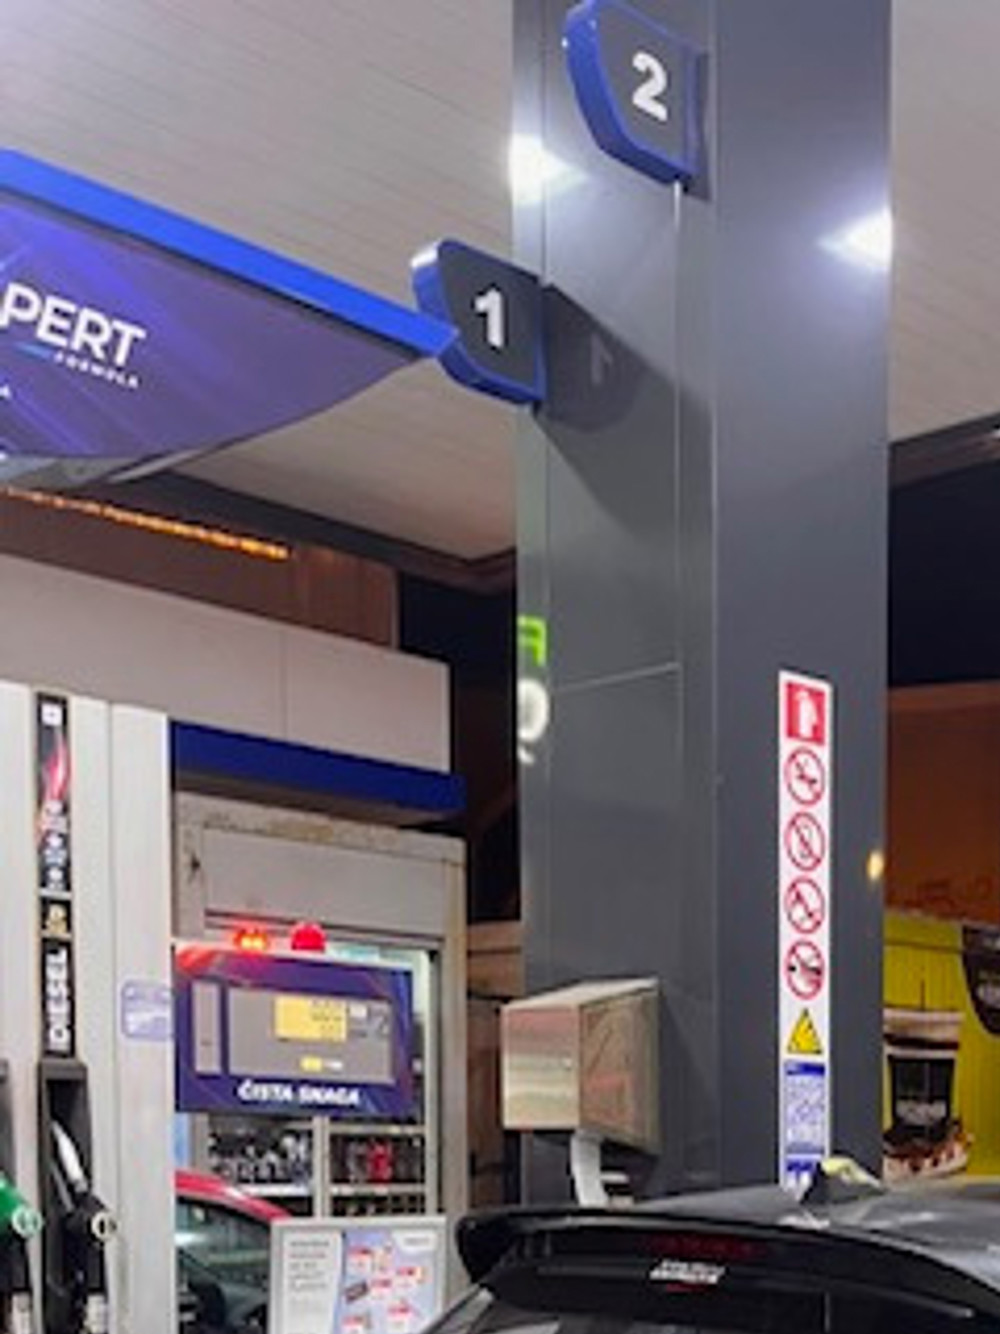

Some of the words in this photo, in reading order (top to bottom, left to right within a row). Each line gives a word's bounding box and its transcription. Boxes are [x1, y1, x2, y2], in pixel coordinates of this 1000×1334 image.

[632, 52, 668, 121] 2
[475, 287, 505, 349] 1
[46, 946, 71, 1051] DIESEL
